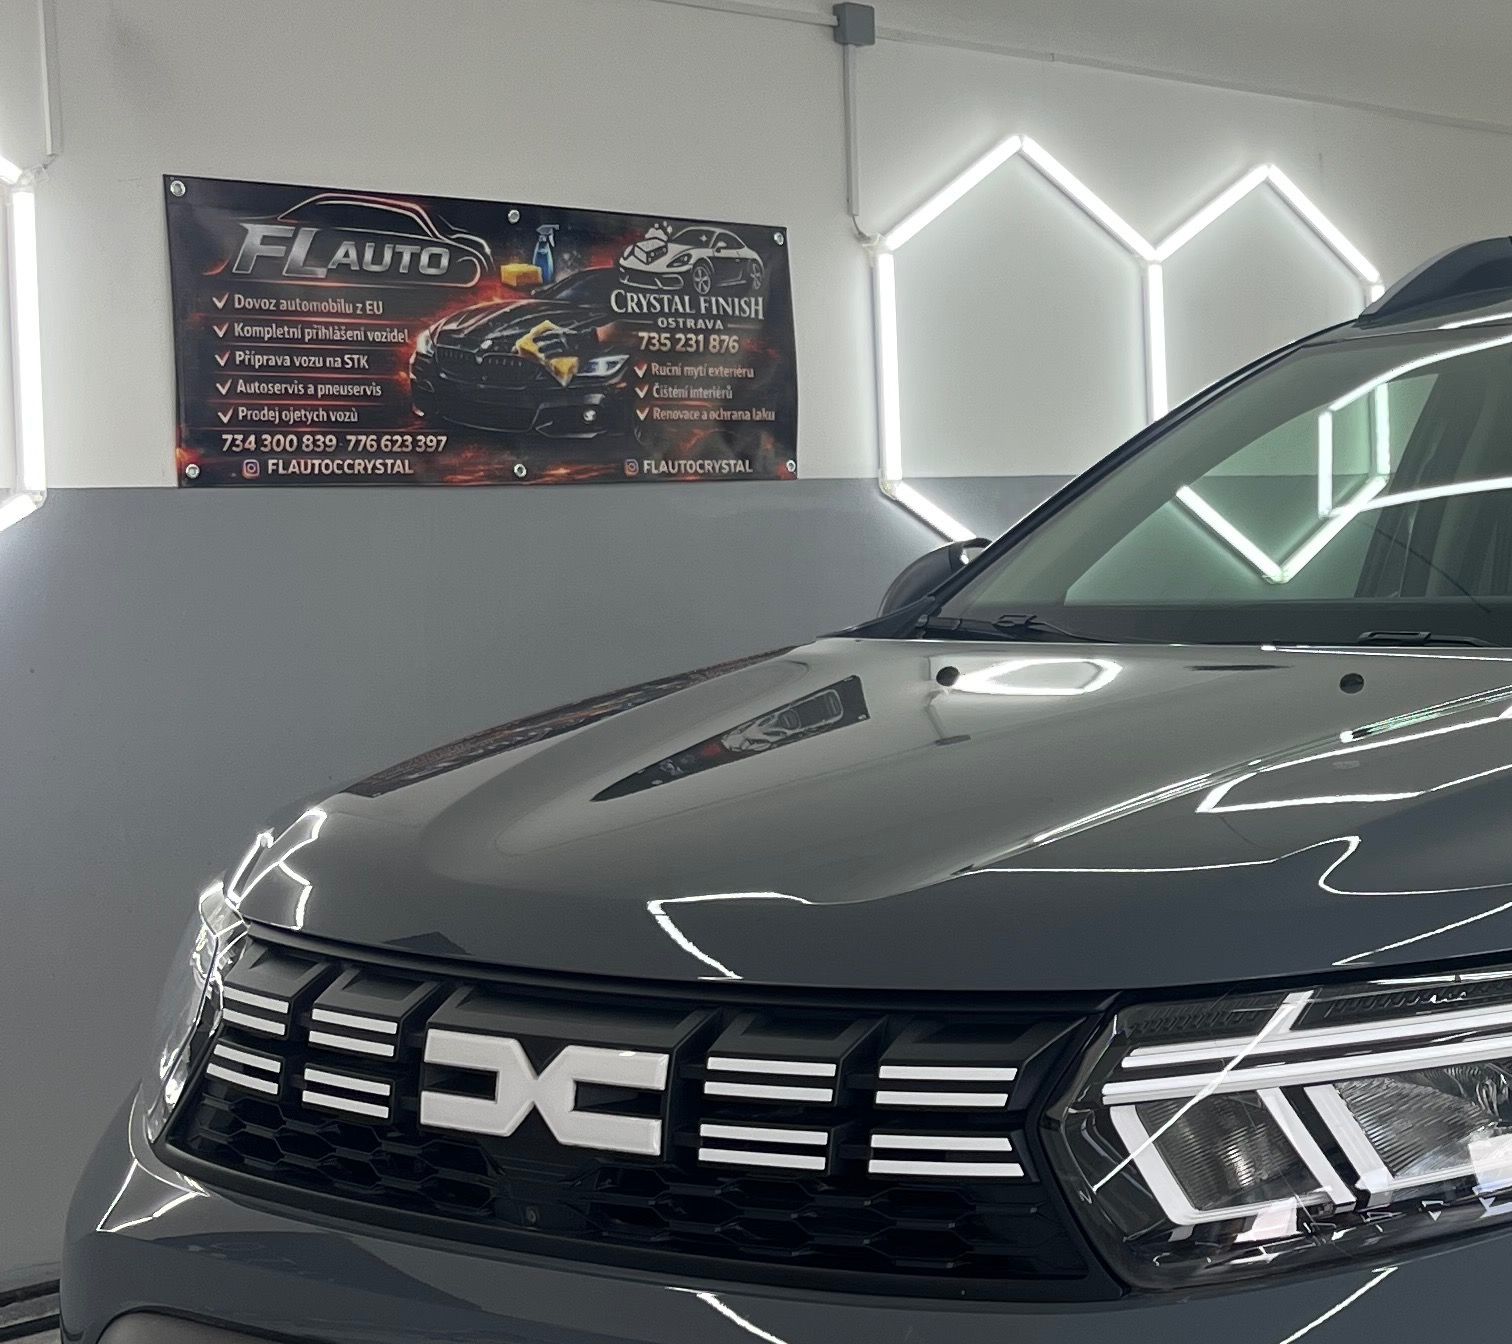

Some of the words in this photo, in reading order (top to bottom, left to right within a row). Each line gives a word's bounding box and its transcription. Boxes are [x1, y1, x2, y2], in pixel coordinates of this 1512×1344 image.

[234, 294, 277, 311] Dovoz
[356, 303, 363, 314] z
[366, 300, 384, 315] EU
[610, 289, 696, 314] CRYSTAL
[700, 296, 764, 320] FINISH
[658, 318, 724, 330] OSTRAVA
[367, 328, 409, 343] vozidel
[638, 332, 671, 351] 735
[675, 333, 704, 352] 231
[709, 335, 739, 354] 876
[235, 350, 291, 369] Příprava
[326, 358, 342, 368] na
[344, 355, 369, 369] STK
[237, 379, 305, 395] Autoservis
[307, 383, 315, 395] a
[317, 382, 382, 398] pneuservis
[238, 407, 280, 424] Prodej
[653, 407, 699, 421] Renovace
[709, 408, 751, 421] ochrana
[752, 408, 776, 422] laku
[222, 434, 256, 452] 734
[260, 434, 298, 452] 300
[302, 434, 337, 452] 839
[346, 435, 377, 452] 776
[380, 435, 412, 452] 623
[415, 436, 448, 452] 397
[268, 459, 415, 475] FLAUTOCCRYSTAL
[643, 459, 754, 474] FLAUTOCRYSTAL
